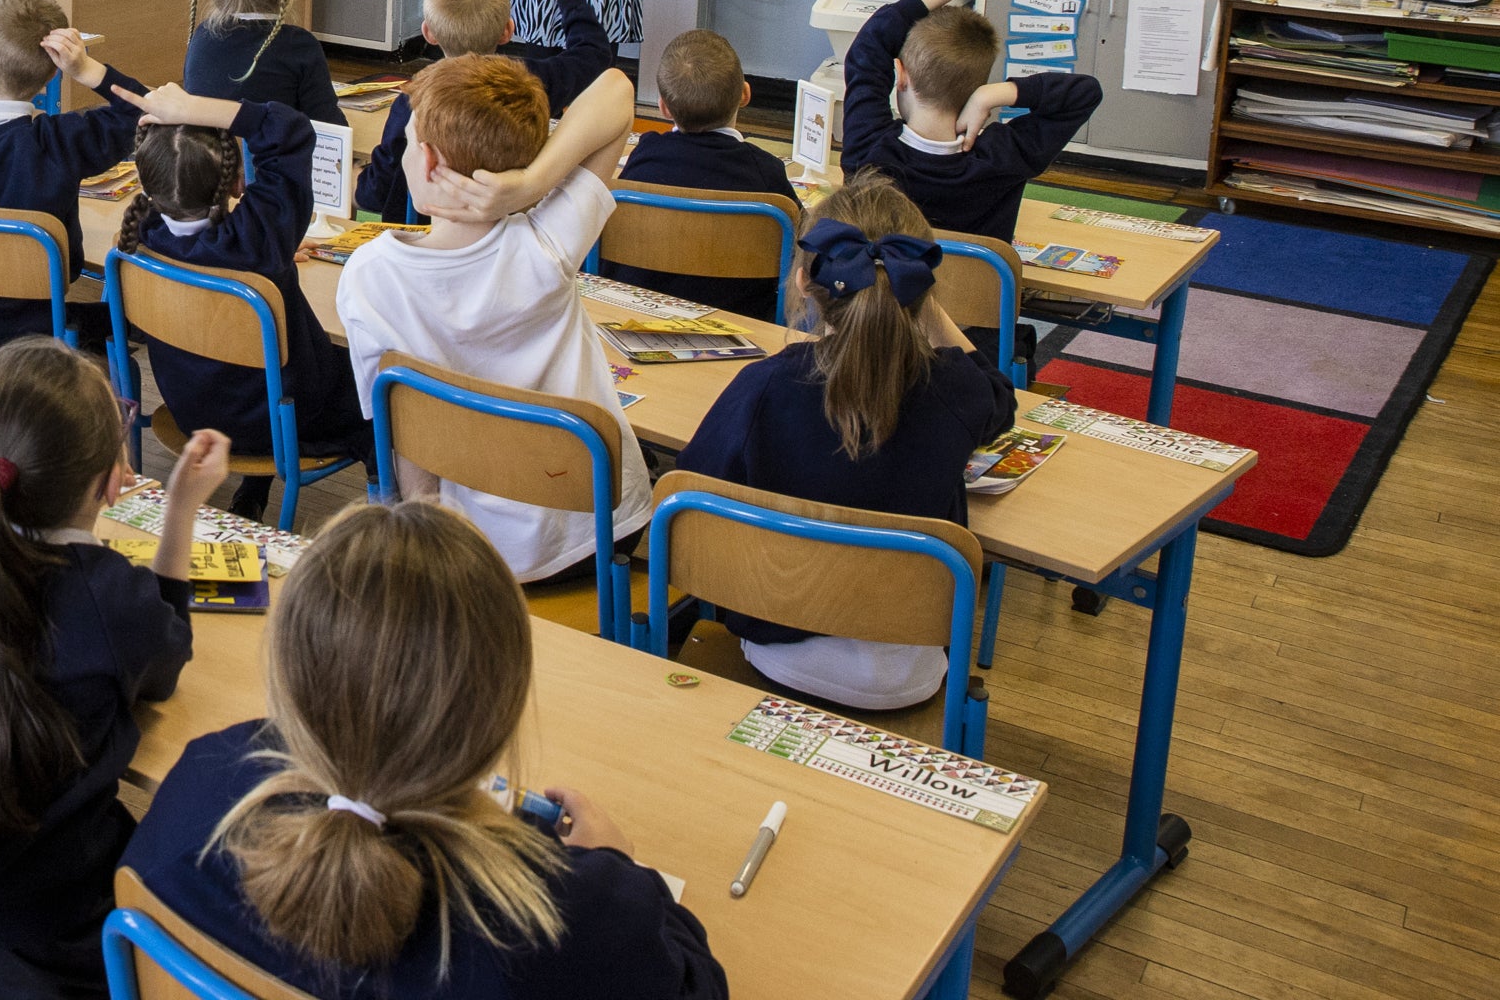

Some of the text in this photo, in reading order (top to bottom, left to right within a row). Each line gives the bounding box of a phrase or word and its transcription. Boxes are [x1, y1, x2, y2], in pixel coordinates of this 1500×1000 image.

[806, 132, 817, 144] line
[1120, 430, 1204, 456] Sophie
[869, 753, 979, 800] Willow
